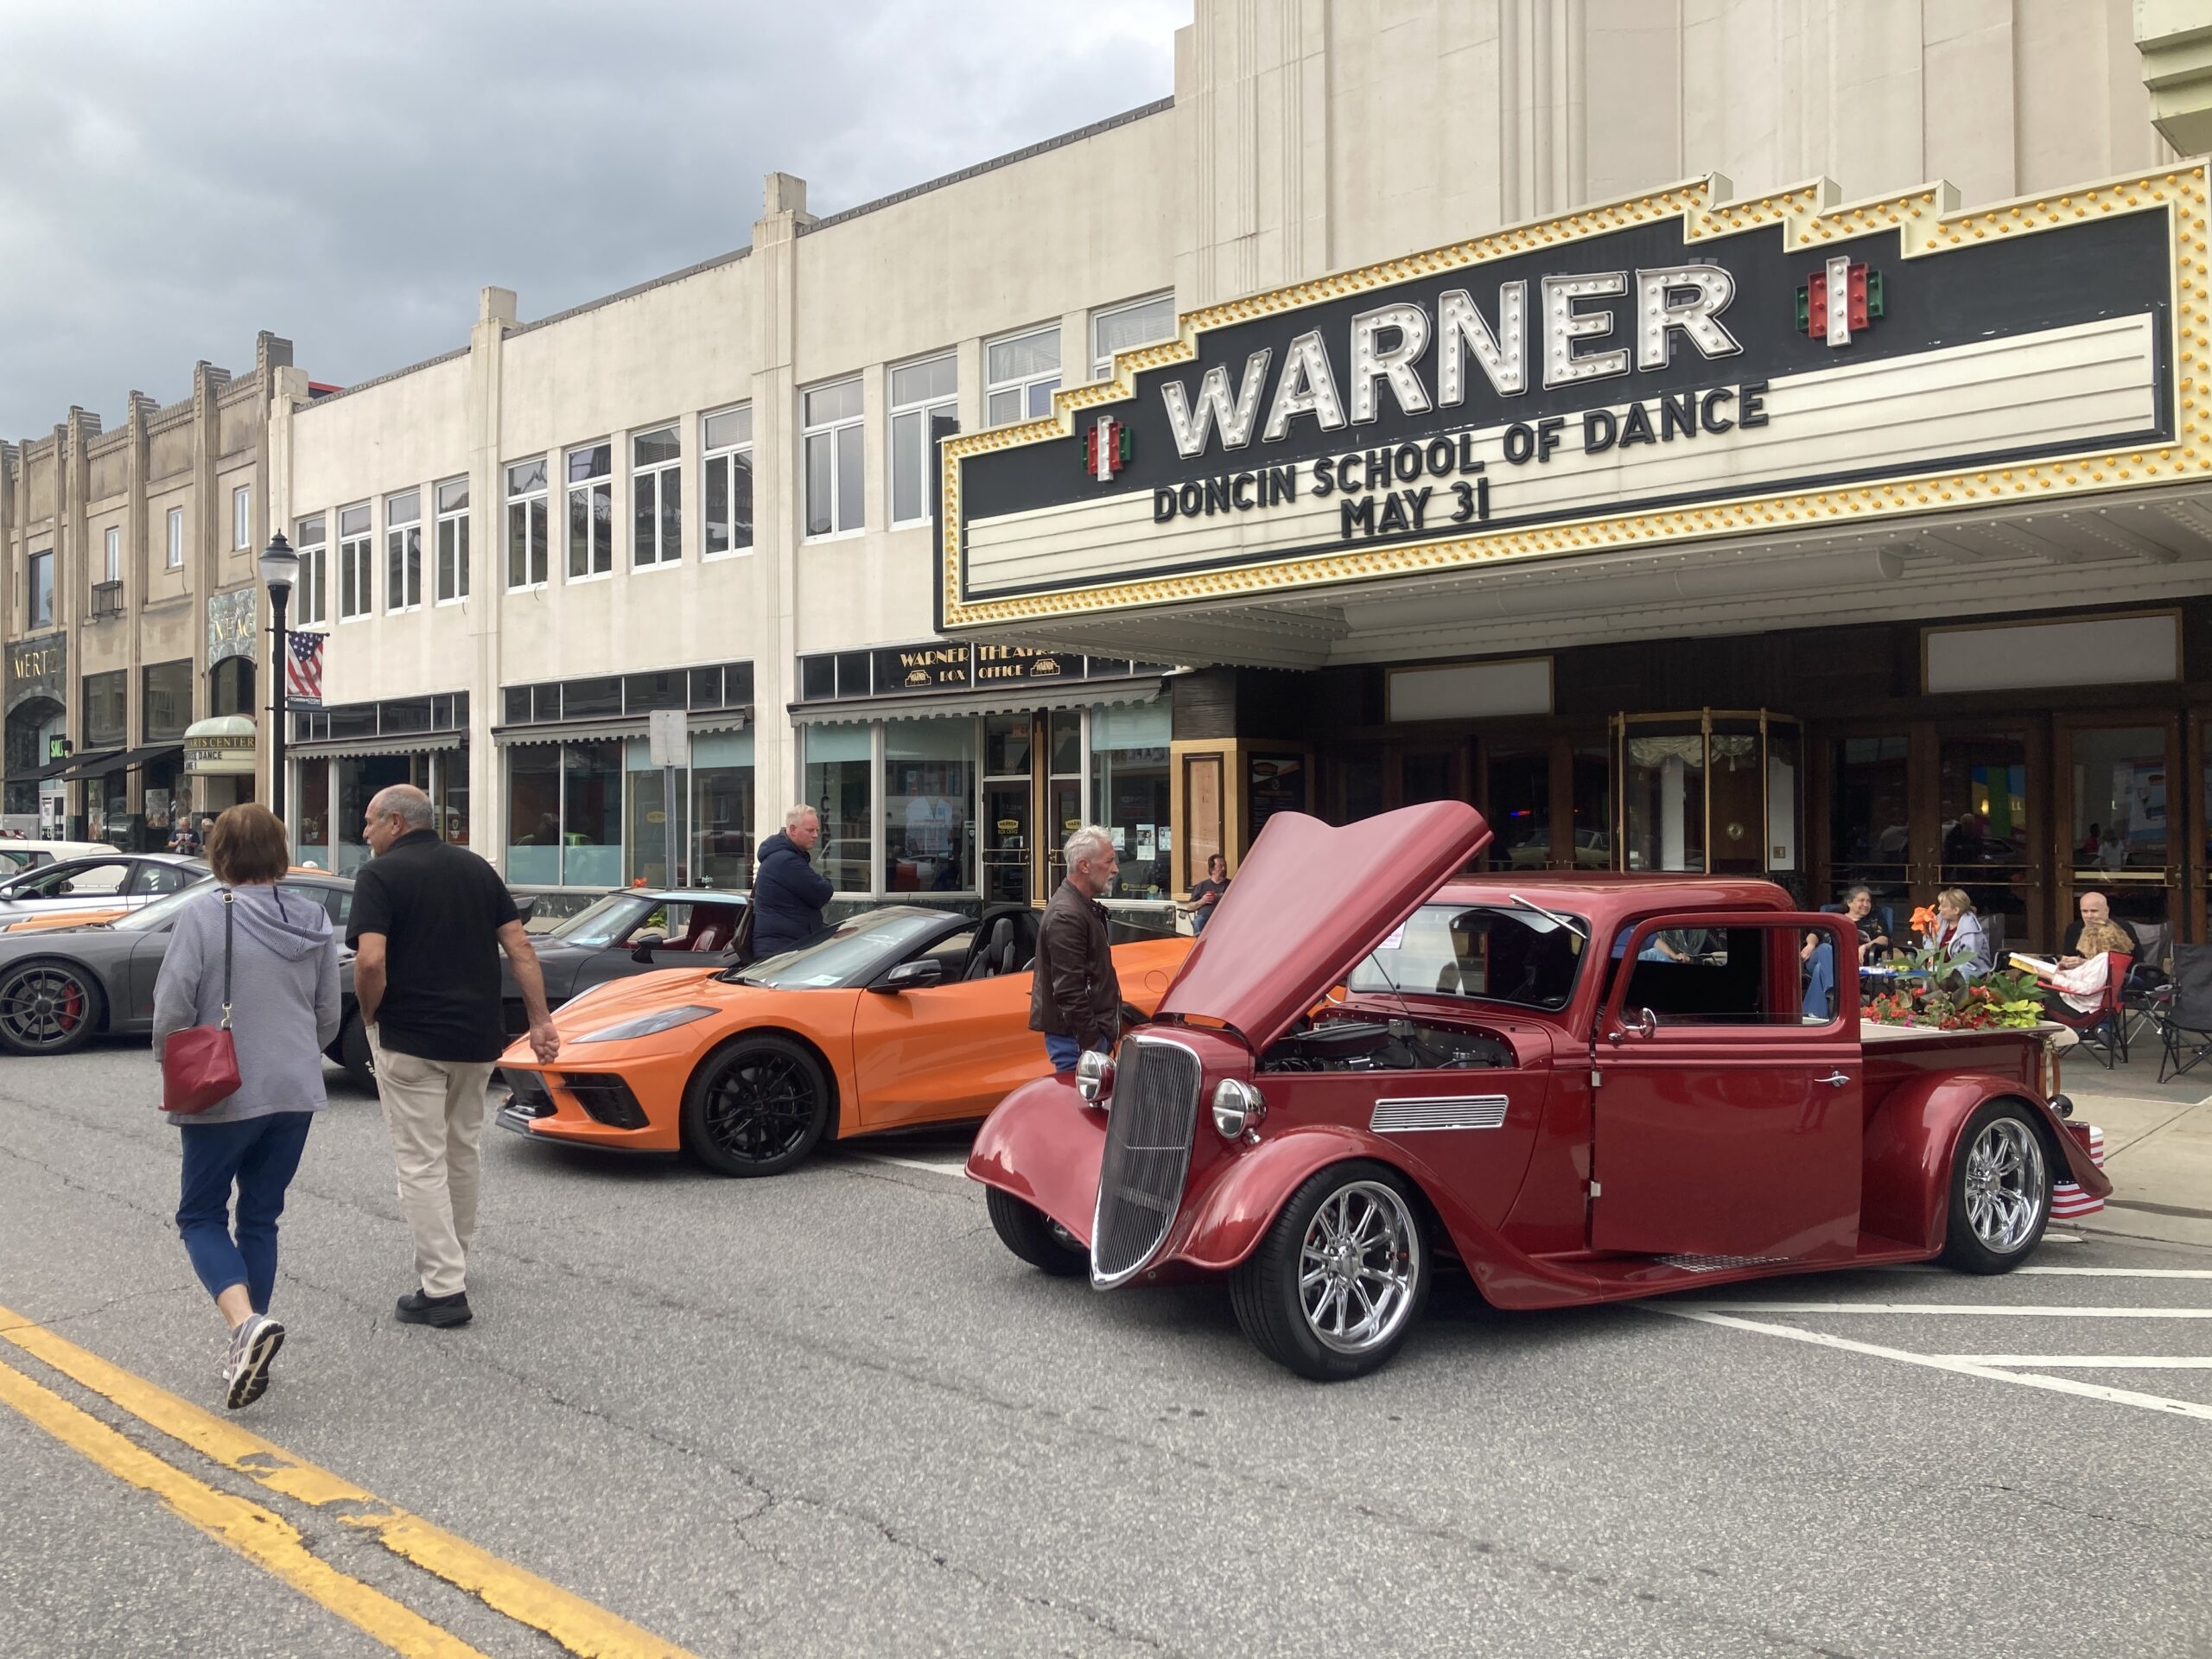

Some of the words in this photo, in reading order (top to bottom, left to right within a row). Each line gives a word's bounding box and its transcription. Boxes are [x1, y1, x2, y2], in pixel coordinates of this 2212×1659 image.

[1160, 264, 1743, 459] WARNER
[1154, 465, 1296, 524] DONCIN
[1312, 433, 1485, 498] SCHOOL
[1503, 416, 1565, 465] OF
[1583, 380, 1770, 455] DANCE
[1341, 485, 1433, 538] MAY
[1451, 477, 1490, 523] 31
[899, 647, 969, 668] WARNER
[939, 669, 966, 683] BOX
[978, 664, 1024, 679] OFFICE
[209, 737, 255, 747] CENTER
[198, 751, 222, 760] DANCE
